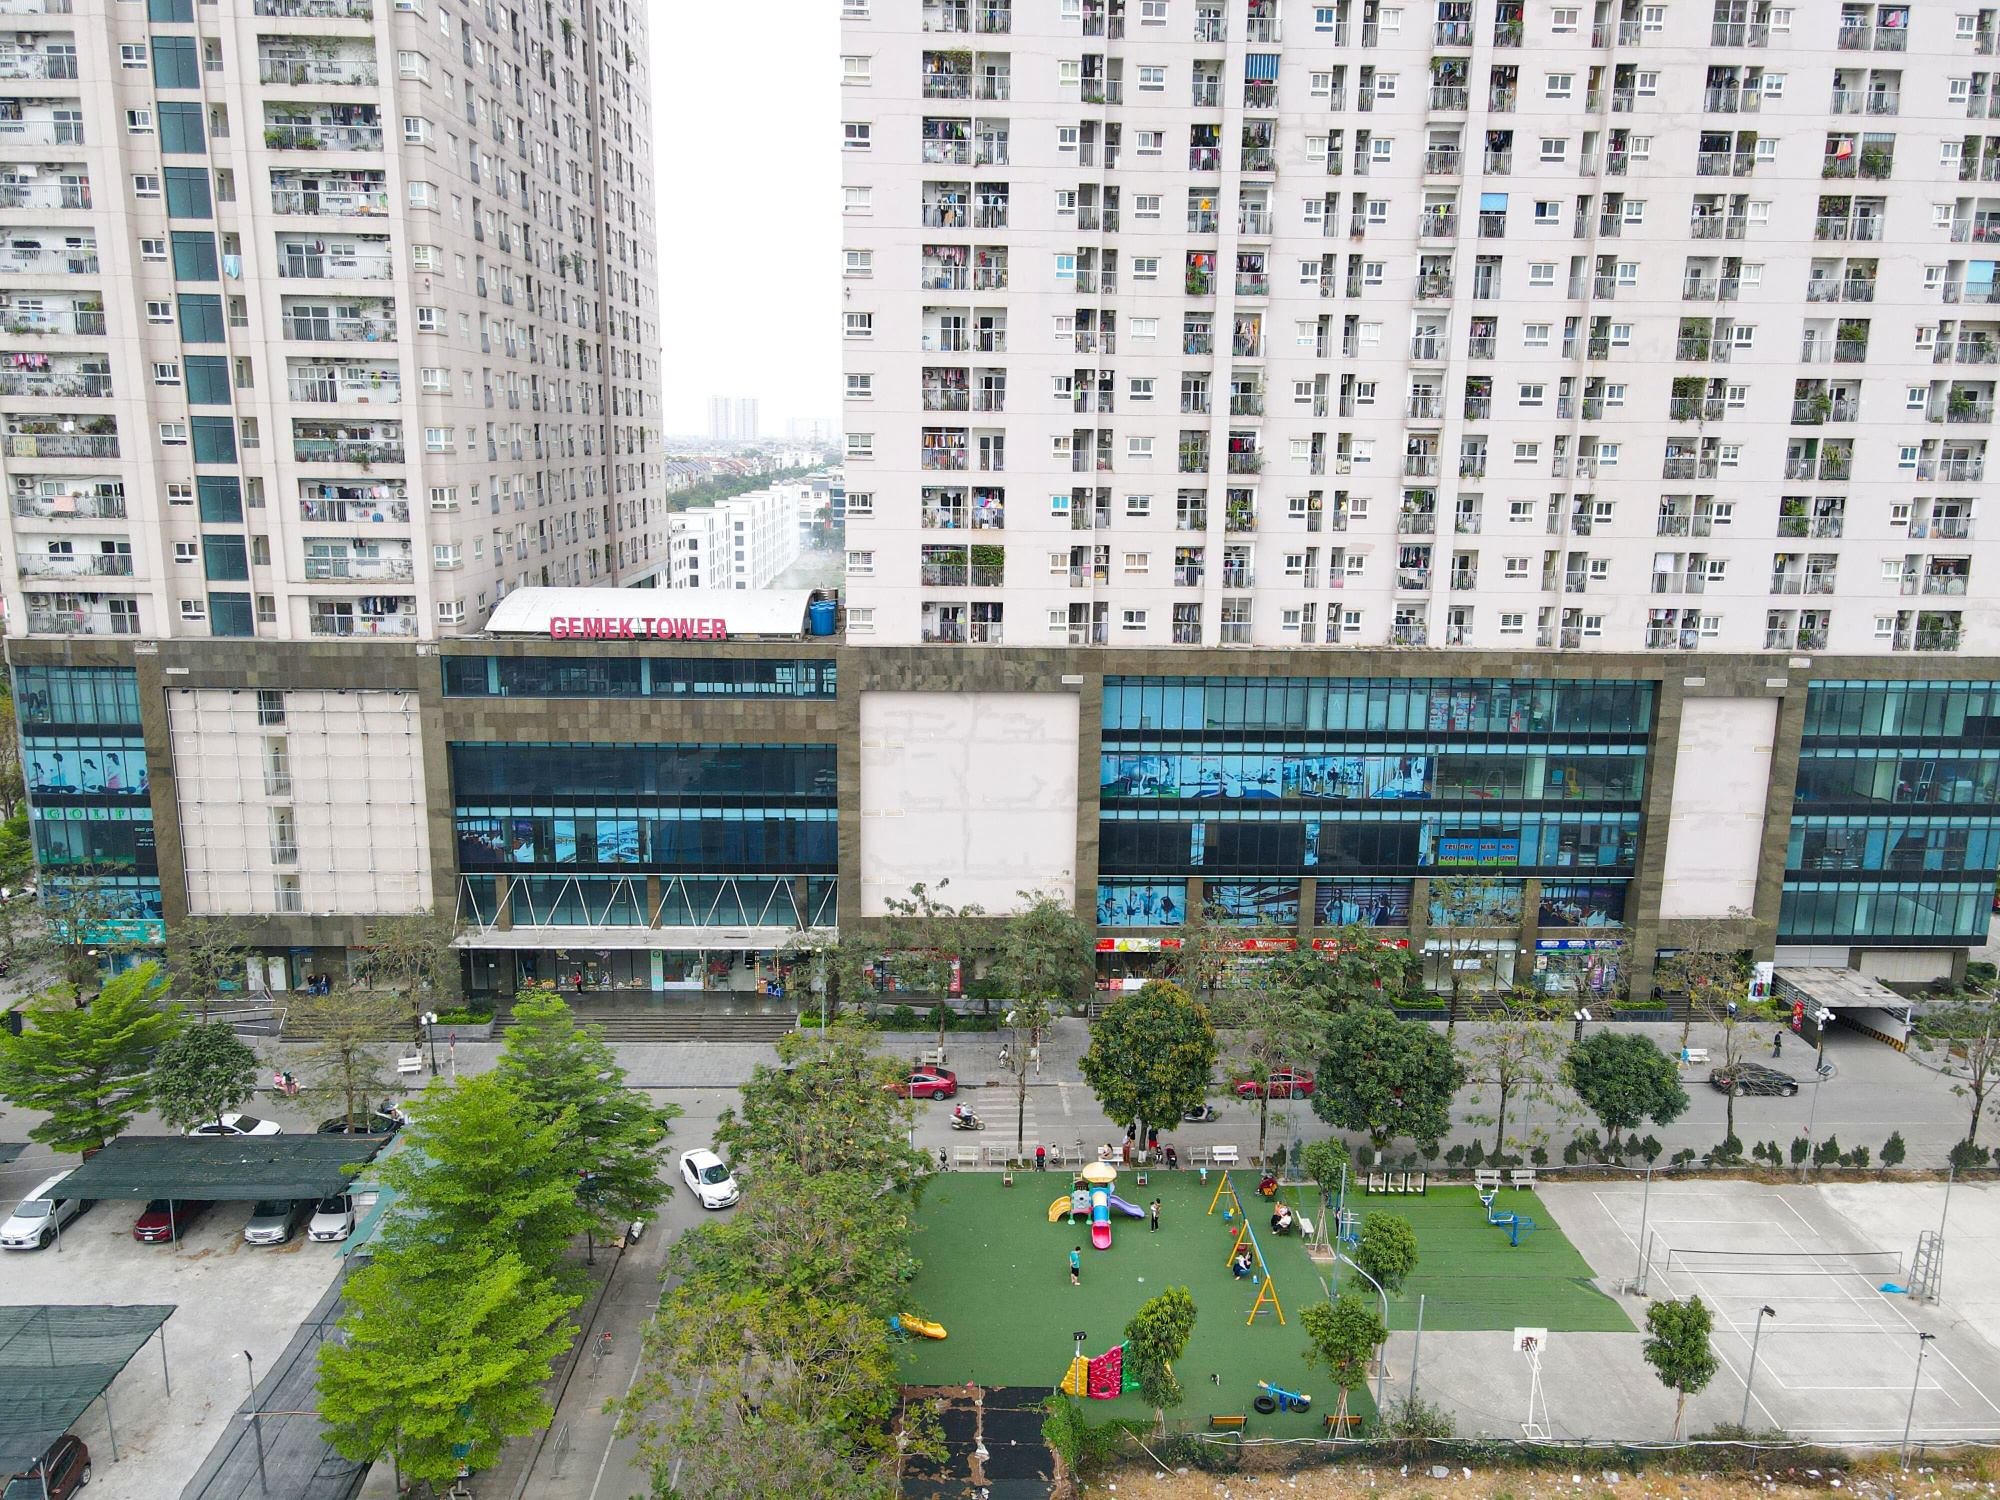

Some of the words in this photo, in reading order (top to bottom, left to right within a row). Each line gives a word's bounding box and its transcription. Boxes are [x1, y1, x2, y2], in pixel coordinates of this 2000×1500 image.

[550, 617, 635, 639] GEMEK
[642, 618, 727, 639] TOWER
[46, 808, 126, 820] GOLF
